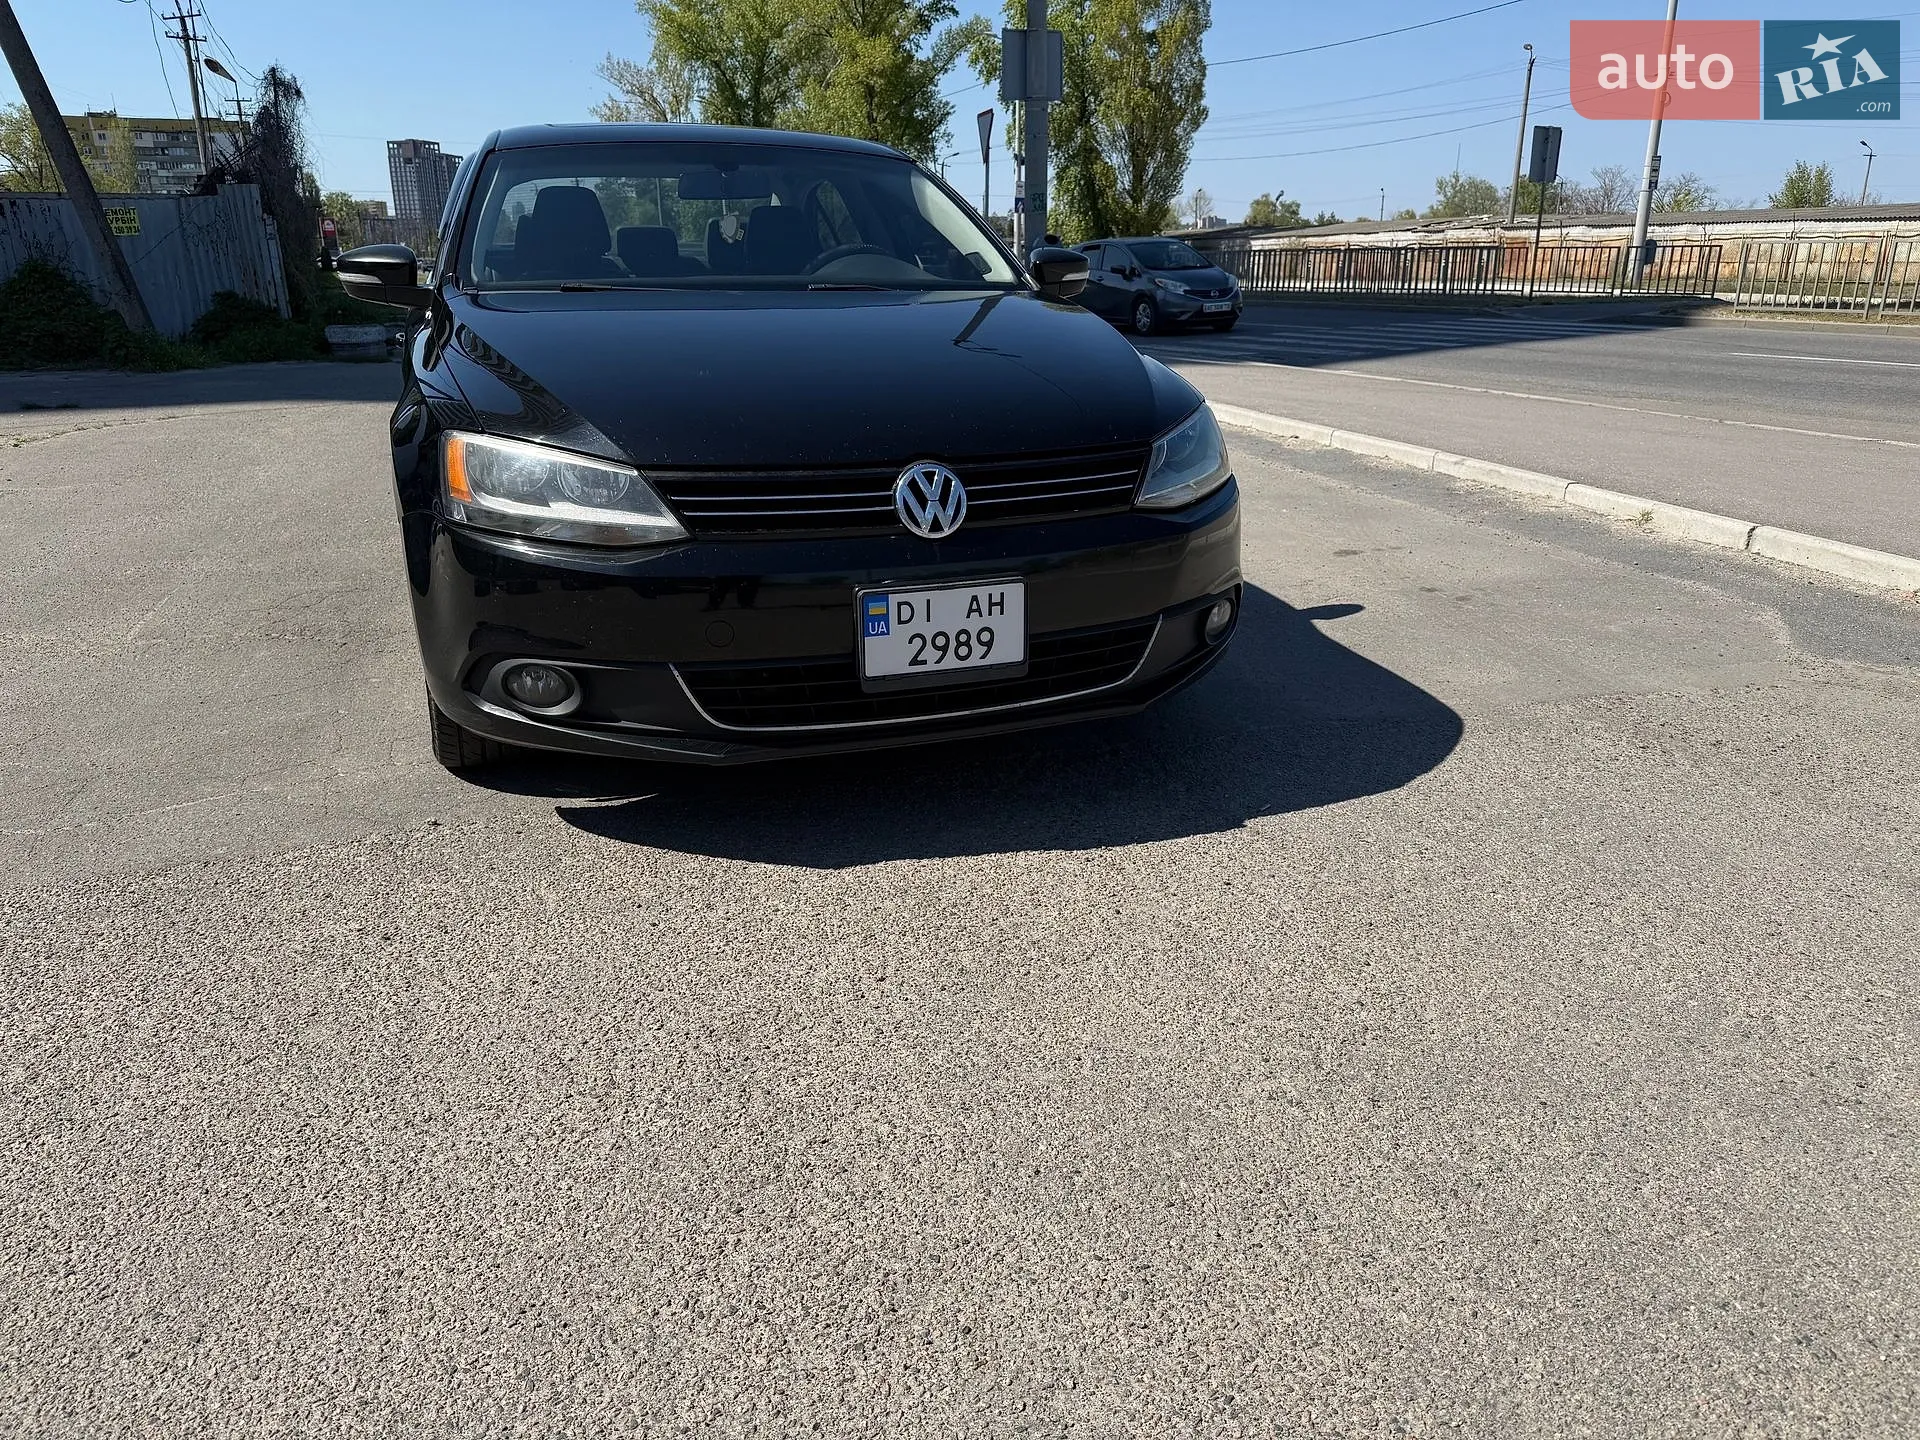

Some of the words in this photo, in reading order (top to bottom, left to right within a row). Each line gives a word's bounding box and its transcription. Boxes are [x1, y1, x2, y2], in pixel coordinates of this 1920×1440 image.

[105, 208, 136, 216] ЕМОНТ
[107, 217, 136, 225] УРБІН
[897, 598, 931, 625] DI
[965, 592, 1005, 619] AH
[869, 621, 887, 634] UA
[907, 626, 995, 667] 2989
